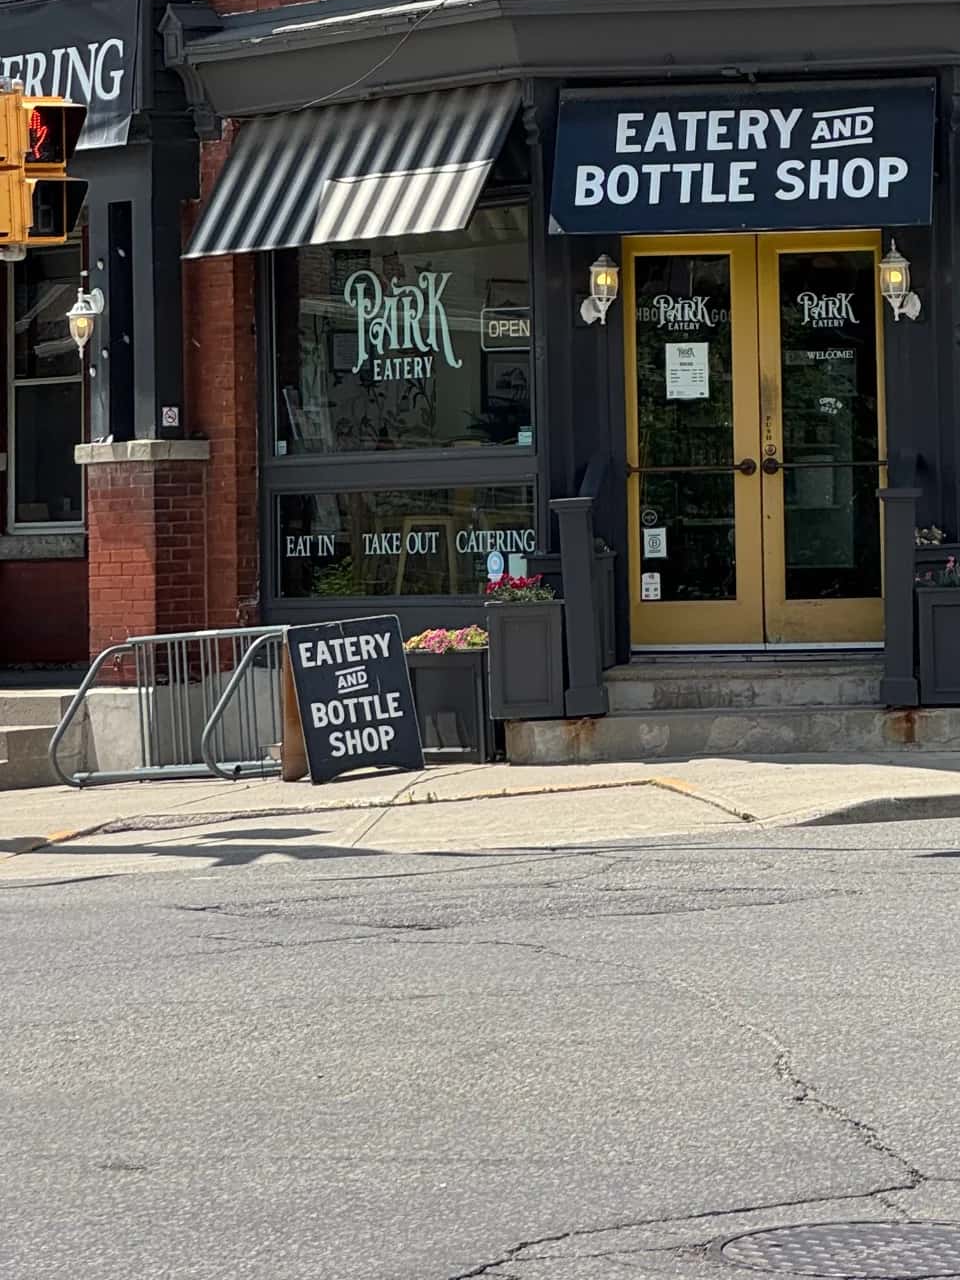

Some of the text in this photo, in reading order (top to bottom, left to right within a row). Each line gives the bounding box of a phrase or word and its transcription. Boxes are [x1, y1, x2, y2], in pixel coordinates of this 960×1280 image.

[615, 108, 874, 154] EATERY AND
[574, 157, 909, 207] BOTTLE SHOP
[344, 270, 463, 374] PARK
[653, 294, 716, 328] PARK
[797, 291, 860, 325] PARK
[812, 319, 845, 328] EATERY
[488, 320, 530, 338] OPEN
[668, 322, 701, 330] EATERY
[373, 356, 433, 381] EATERY
[807, 350, 854, 360] WELCOME!
[286, 529, 535, 557] EAT IN TAKE OUT CATERING
[299, 632, 391, 668] EATERY
[337, 669, 368, 691] AND
[310, 692, 404, 728] BOTTLE
[329, 725, 395, 757] SHOP
